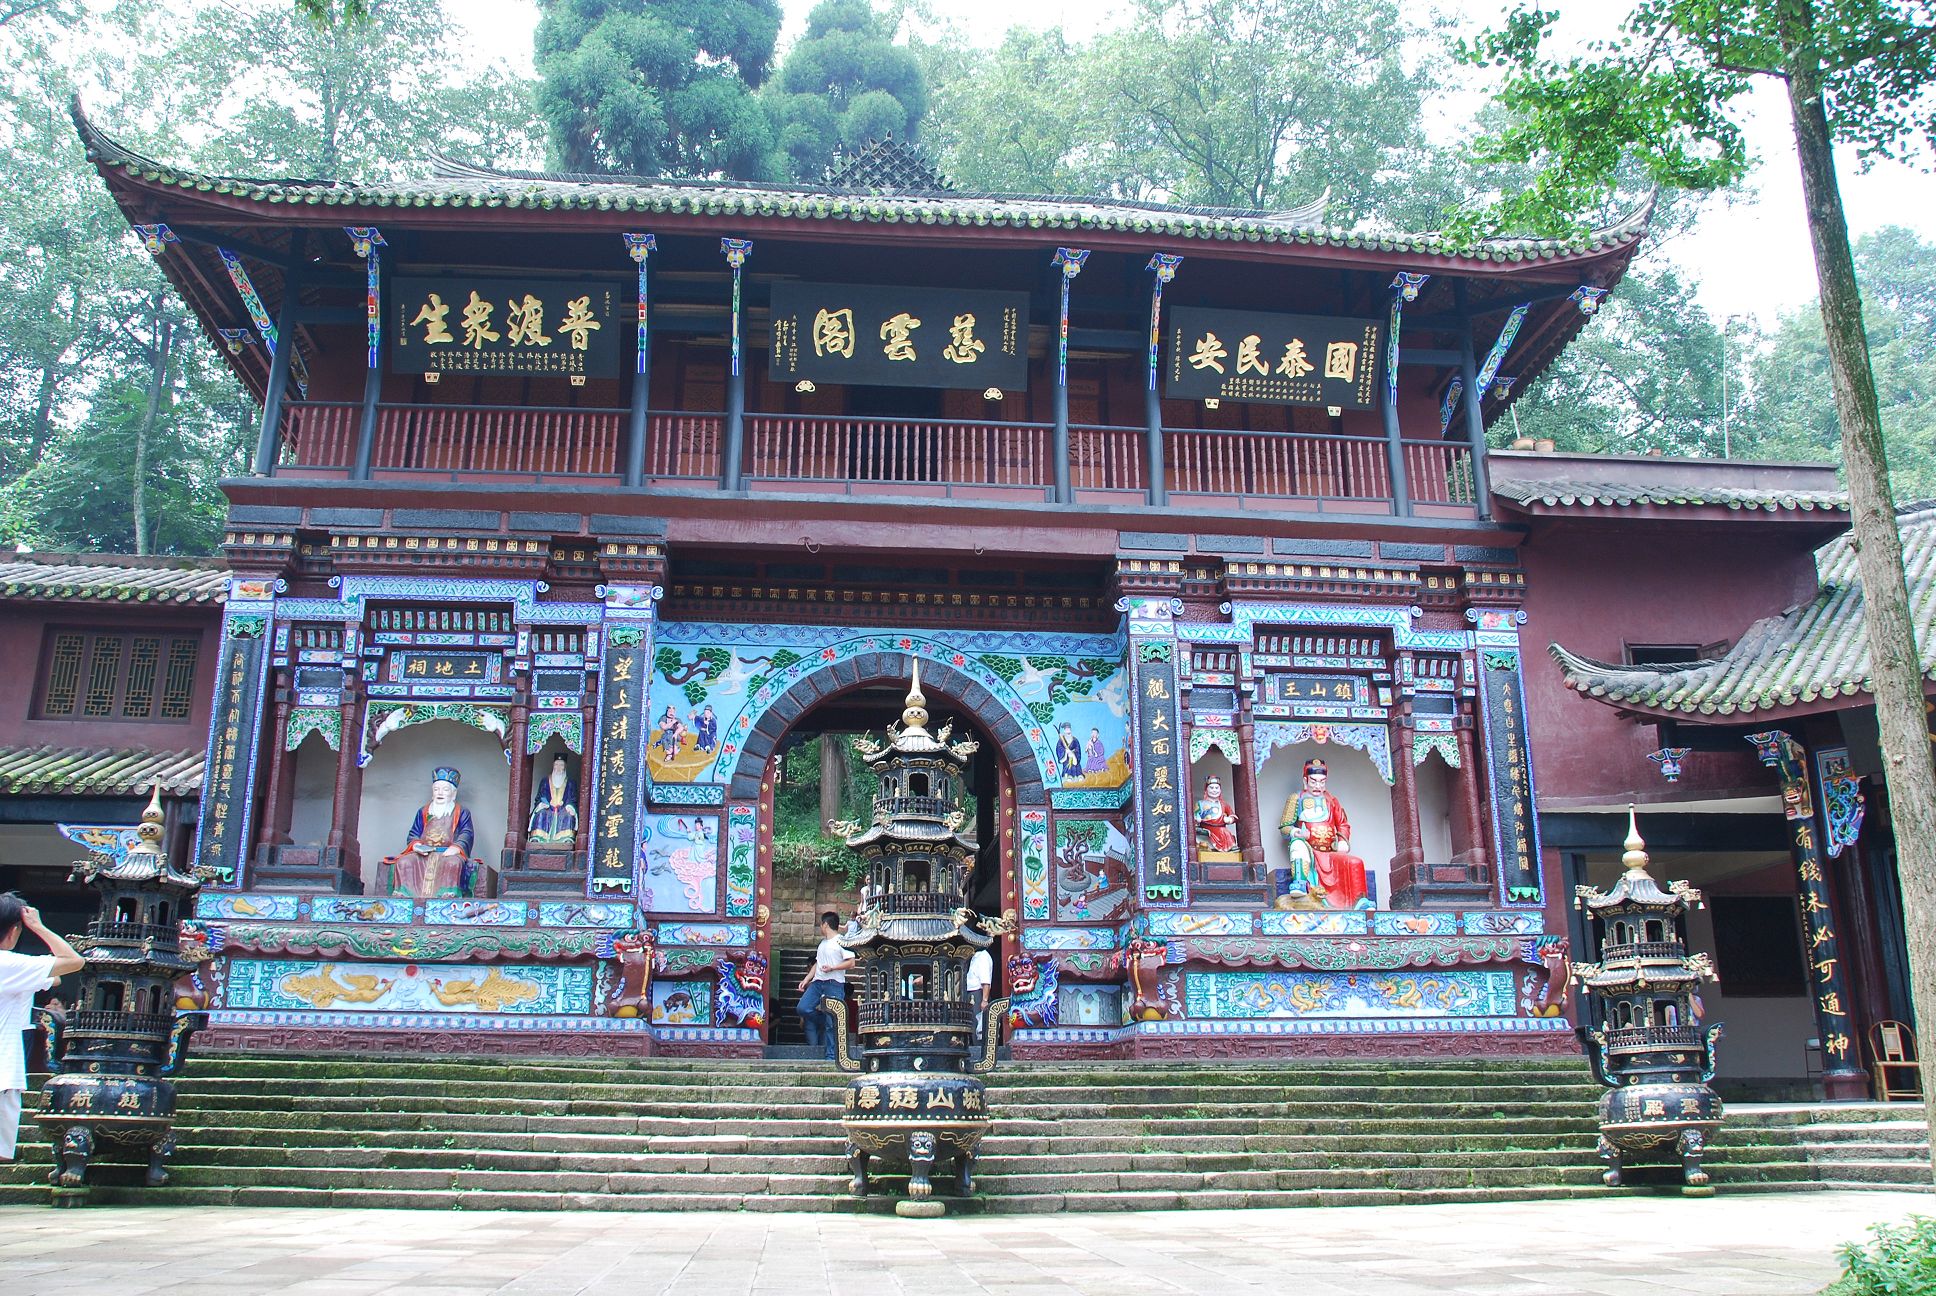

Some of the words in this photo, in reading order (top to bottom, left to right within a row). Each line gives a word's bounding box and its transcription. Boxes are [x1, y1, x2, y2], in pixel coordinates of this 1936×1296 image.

[813, 307, 985, 364] 慈雲閣
[1188, 332, 1357, 384] 國泰民安
[408, 658, 482, 676] 土地祠
[1283, 682, 1353, 701] 鎮山王
[1795, 825, 1849, 1061] 有錢未必可通神
[844, 1085, 986, 1110] 城山慈雲閣
